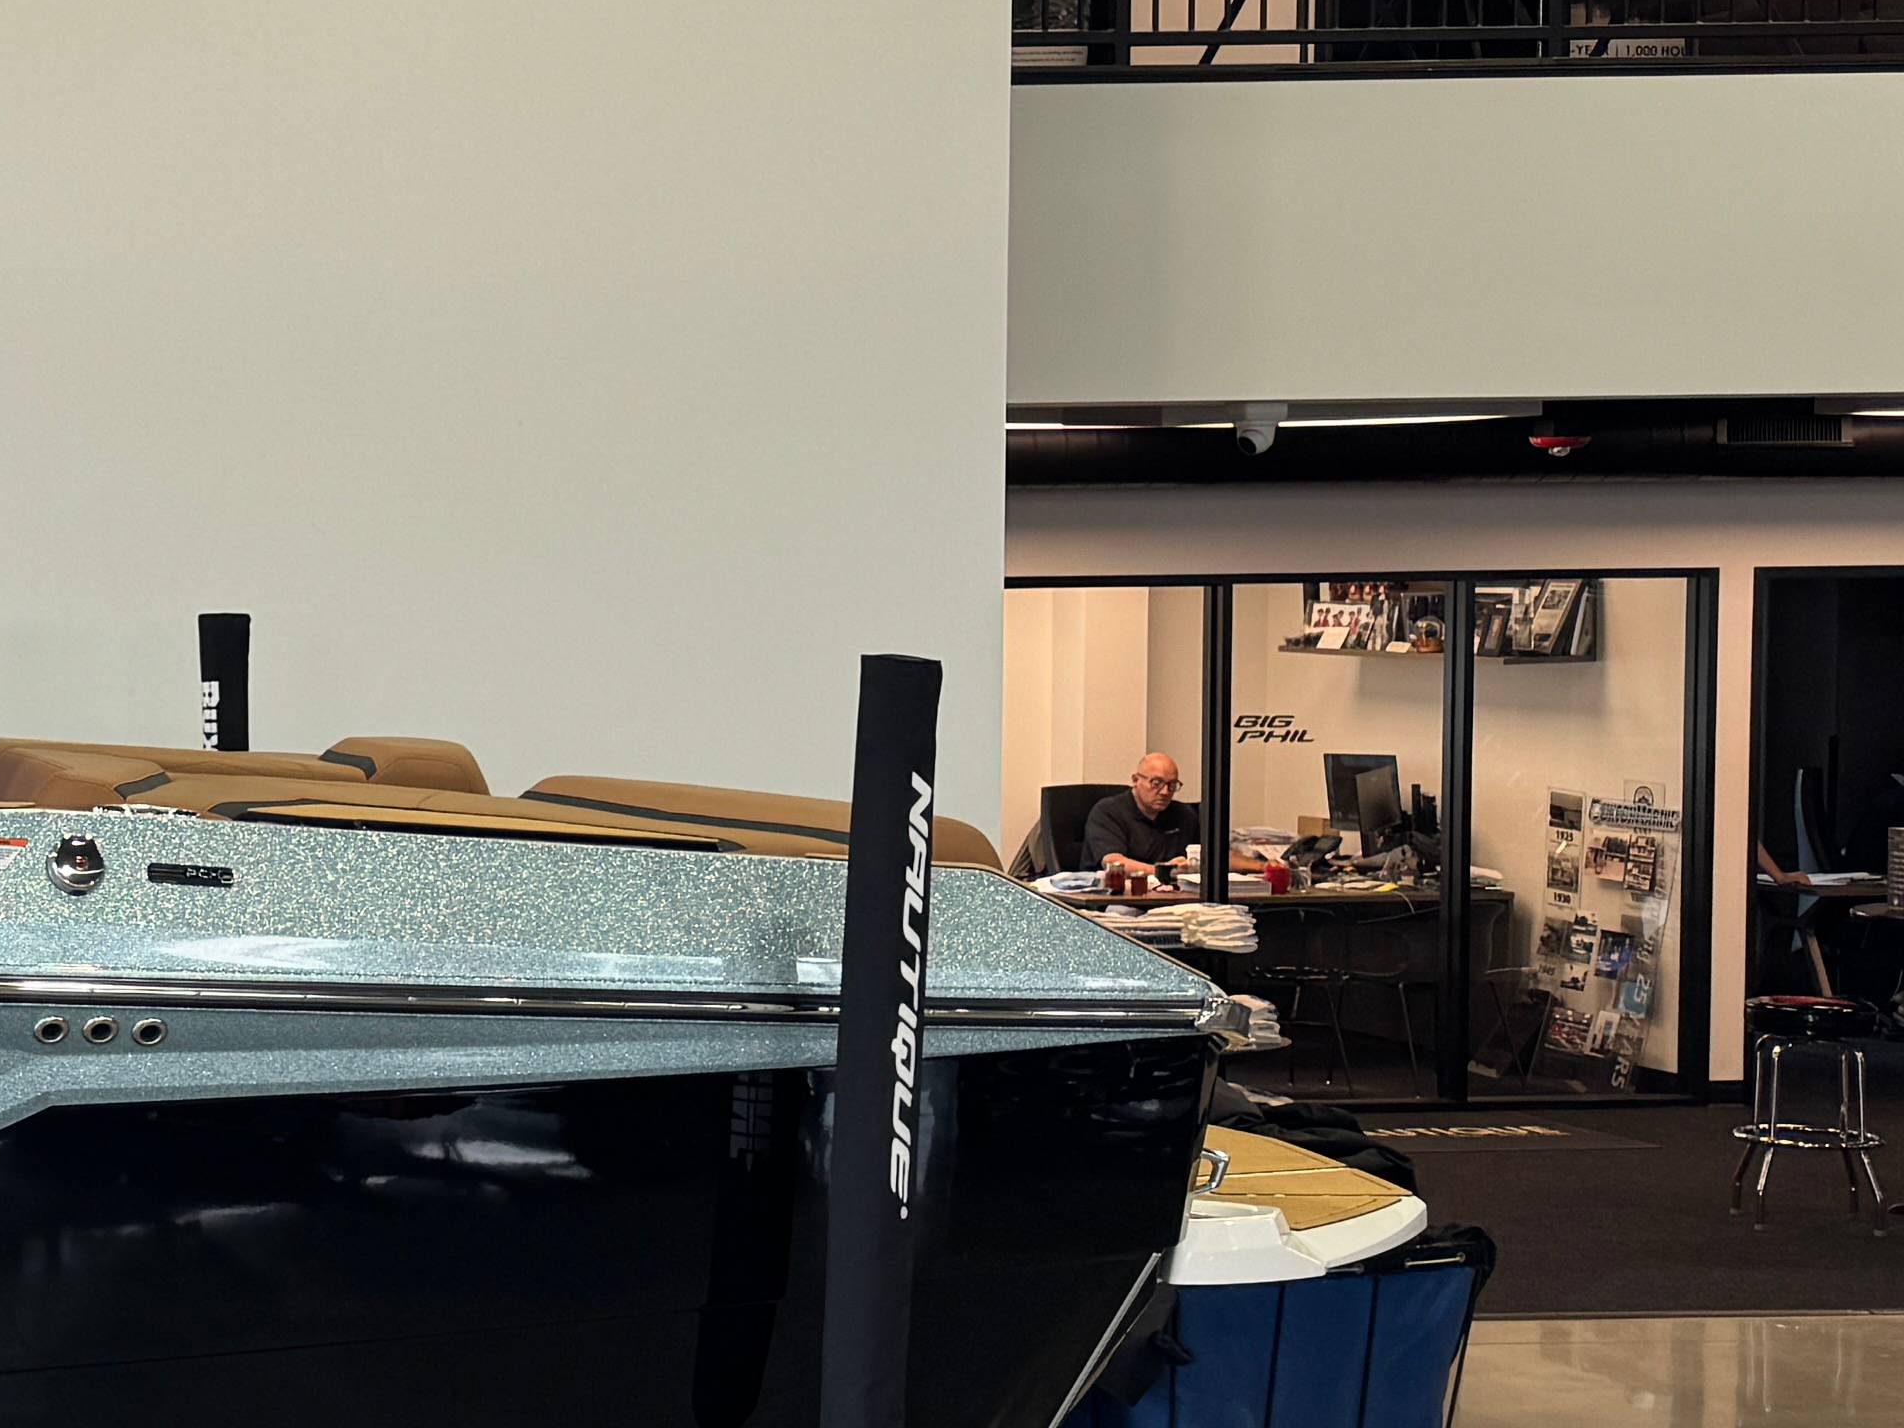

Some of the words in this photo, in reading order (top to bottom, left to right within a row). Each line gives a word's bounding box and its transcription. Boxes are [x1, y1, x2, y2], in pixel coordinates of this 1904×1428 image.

[1234, 715, 1295, 728] BIG
[1237, 730, 1314, 743] PHIL
[889, 770, 933, 1208] NAUTIQUE
